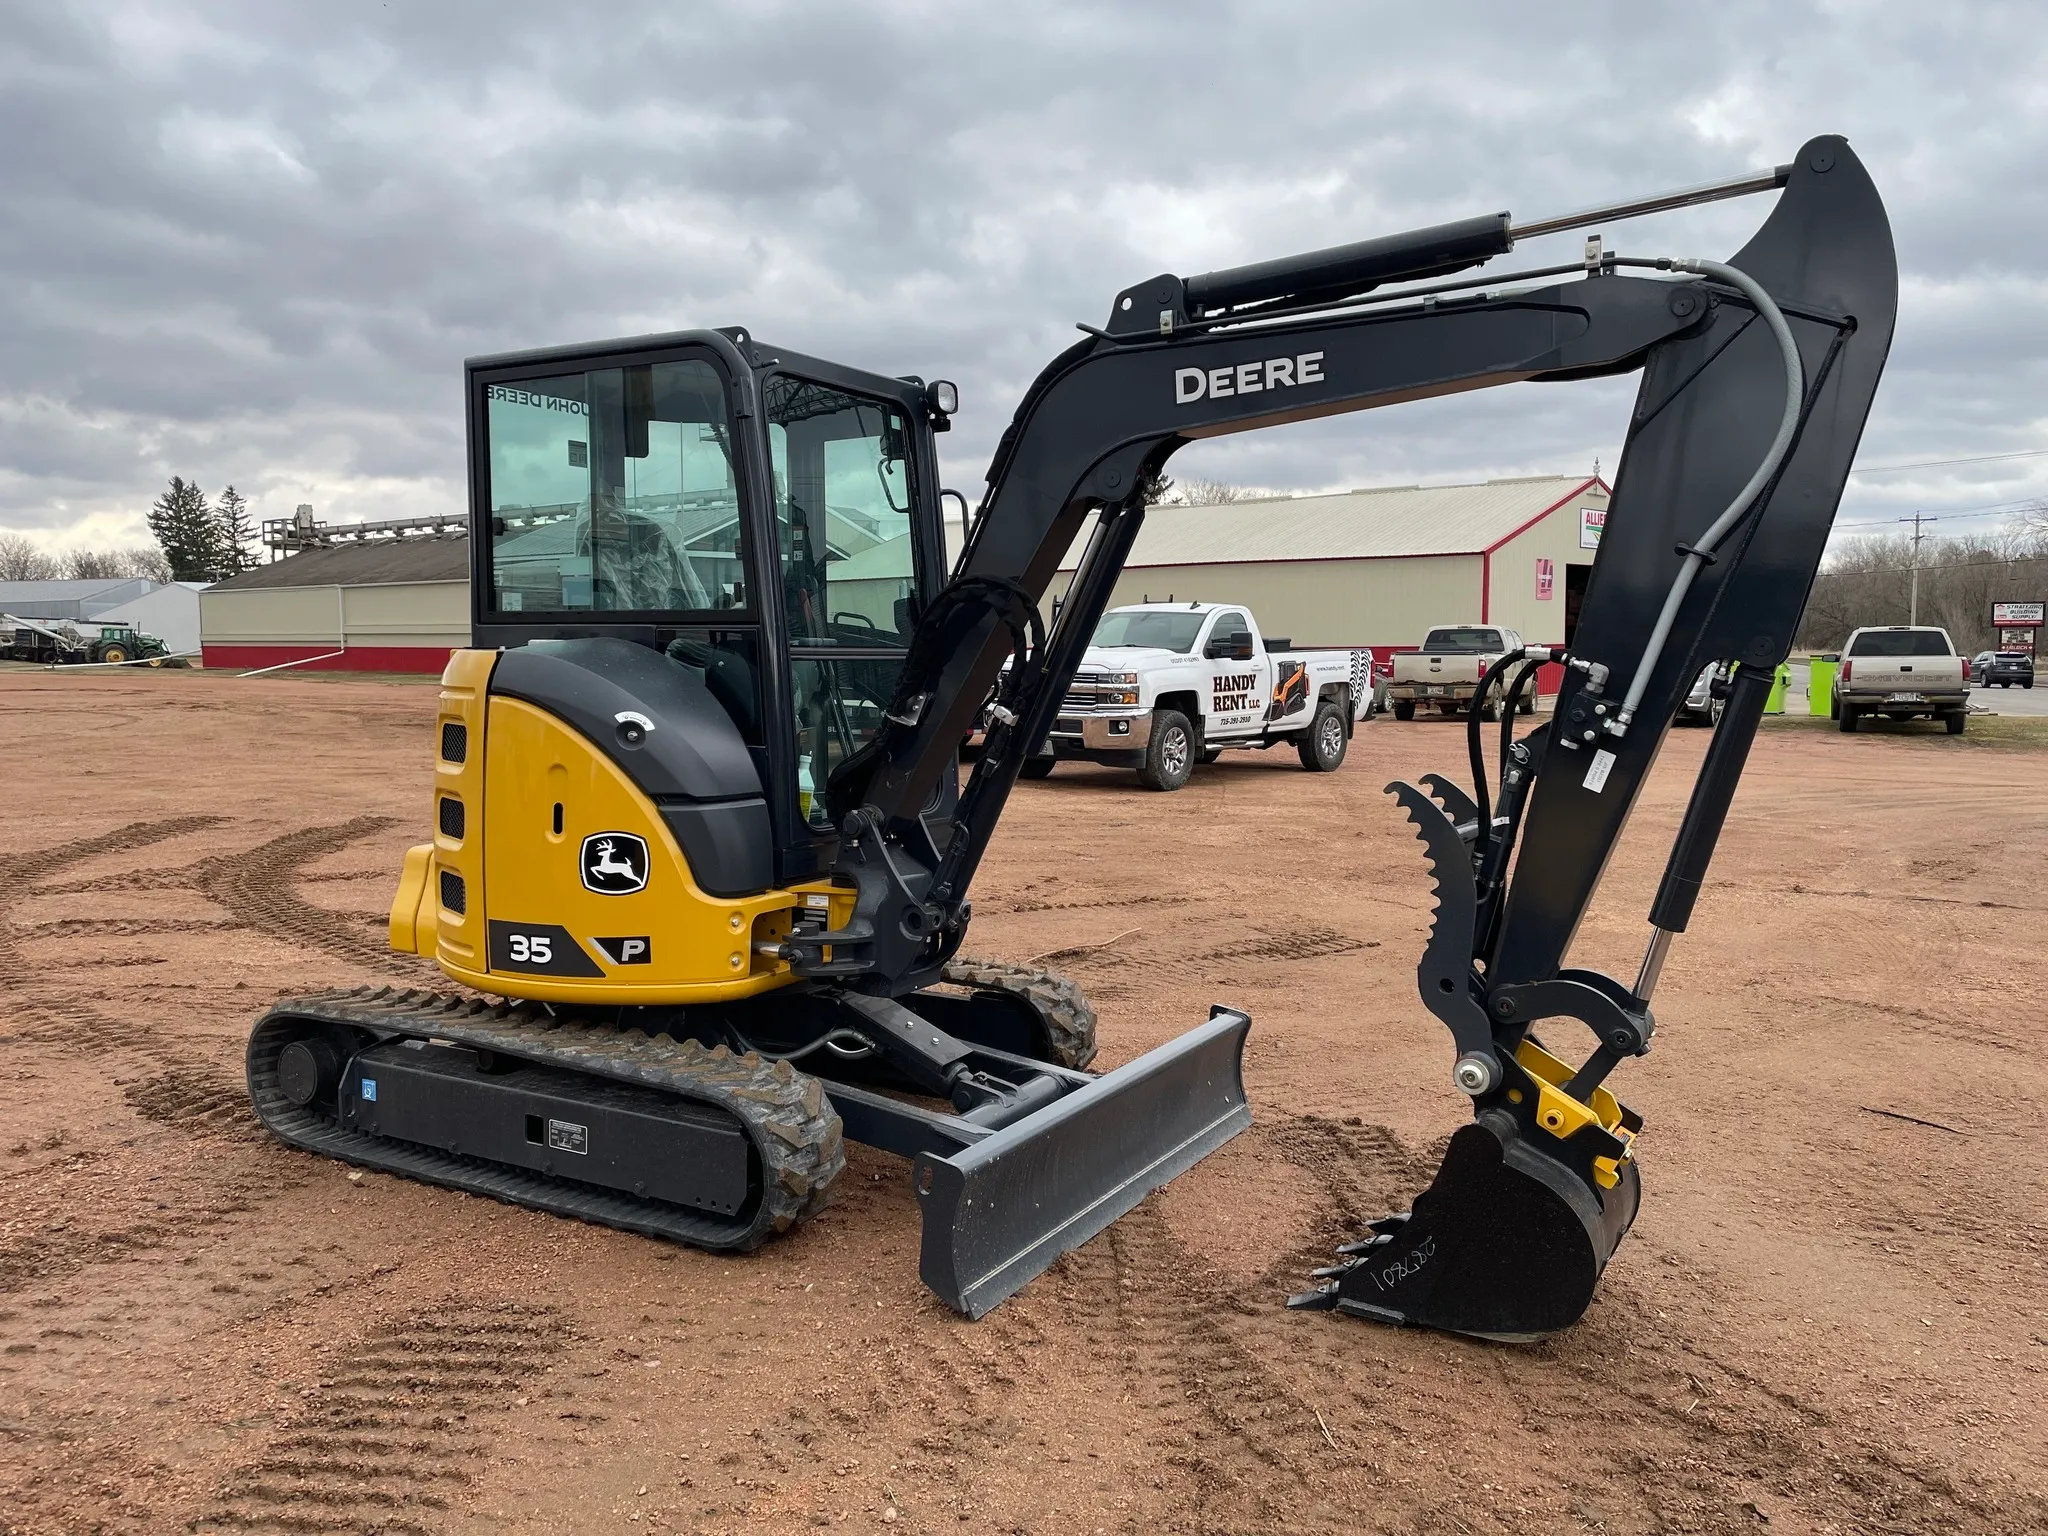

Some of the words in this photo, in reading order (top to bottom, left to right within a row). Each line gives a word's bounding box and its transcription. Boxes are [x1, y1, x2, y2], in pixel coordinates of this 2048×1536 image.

[1175, 351, 1325, 404] DEERE
[1213, 674, 1257, 693] HANDY
[1861, 674, 1953, 682] CHEVROLET
[1213, 694, 1248, 712] RENT
[1248, 699, 1261, 710] LLC
[509, 934, 553, 964] 35
[621, 939, 646, 962] P
